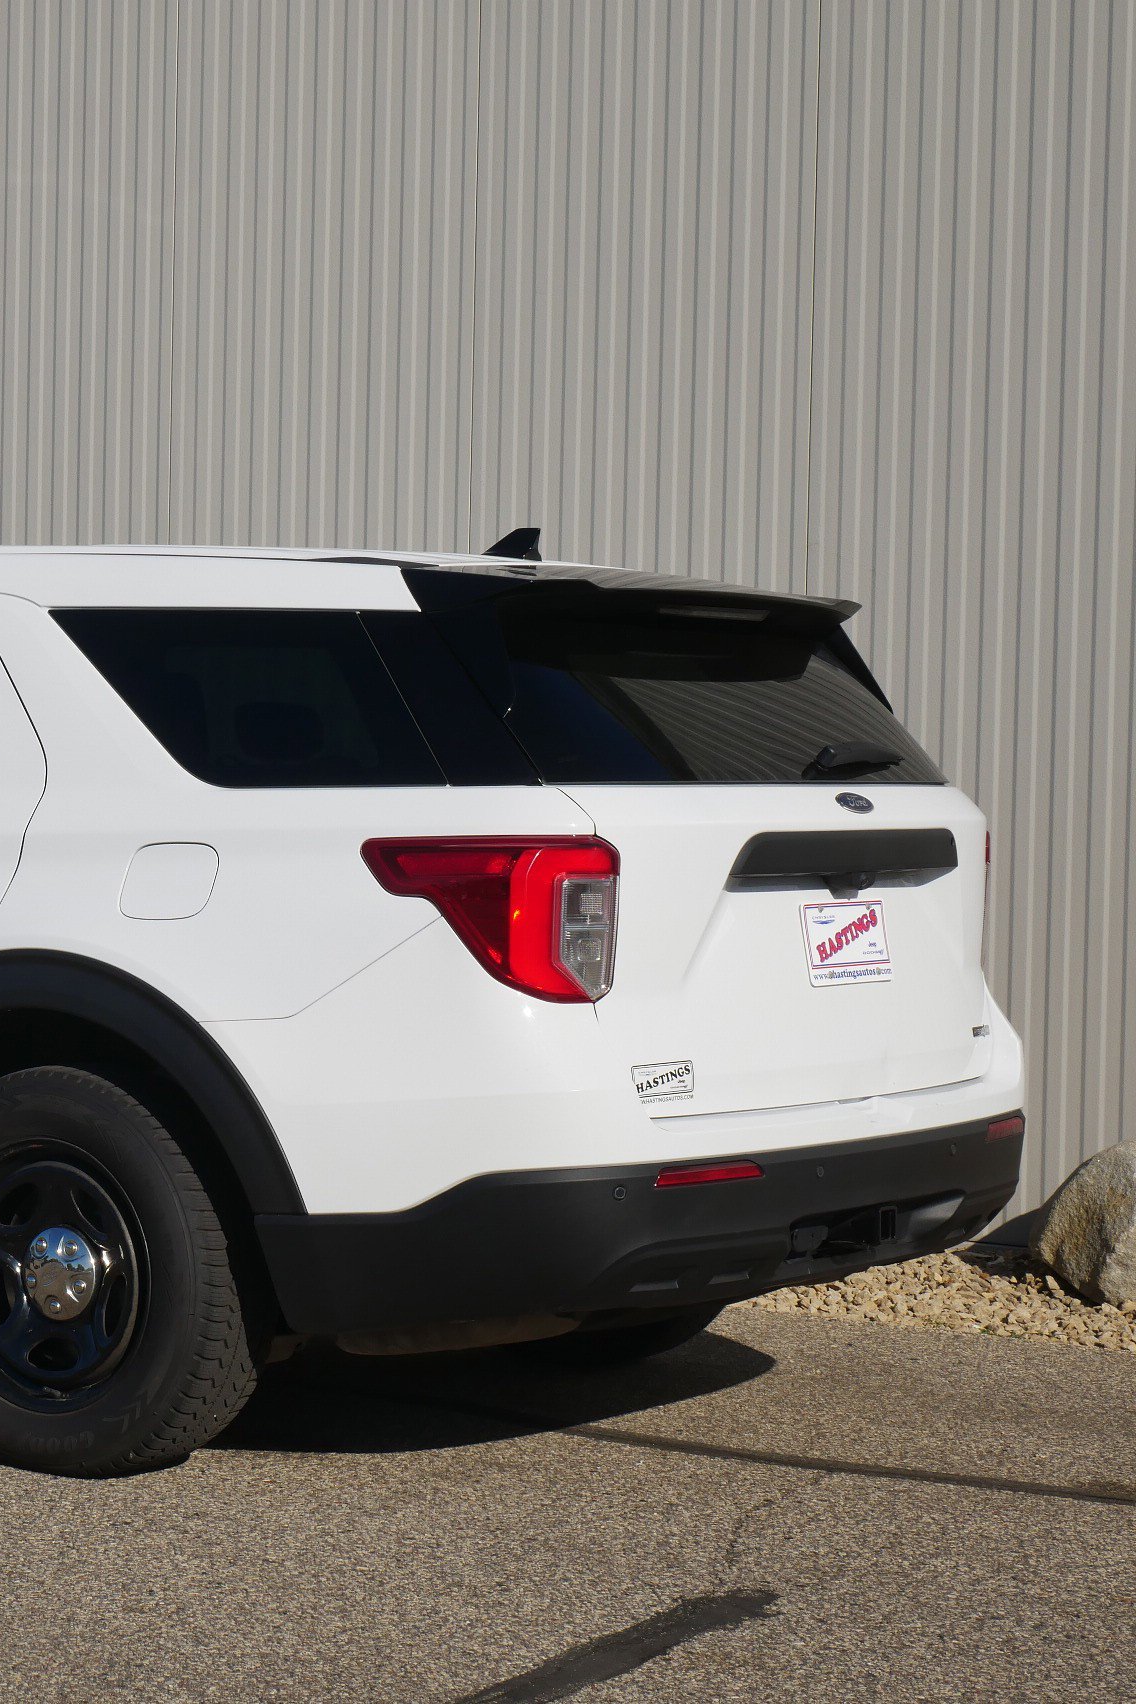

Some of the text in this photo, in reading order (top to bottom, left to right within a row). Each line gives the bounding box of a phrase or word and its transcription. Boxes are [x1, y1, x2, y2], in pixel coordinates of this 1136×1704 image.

[847, 794, 868, 807] Ford
[816, 908, 878, 963] HASTINGS
[635, 1064, 691, 1094] HASTINGS
